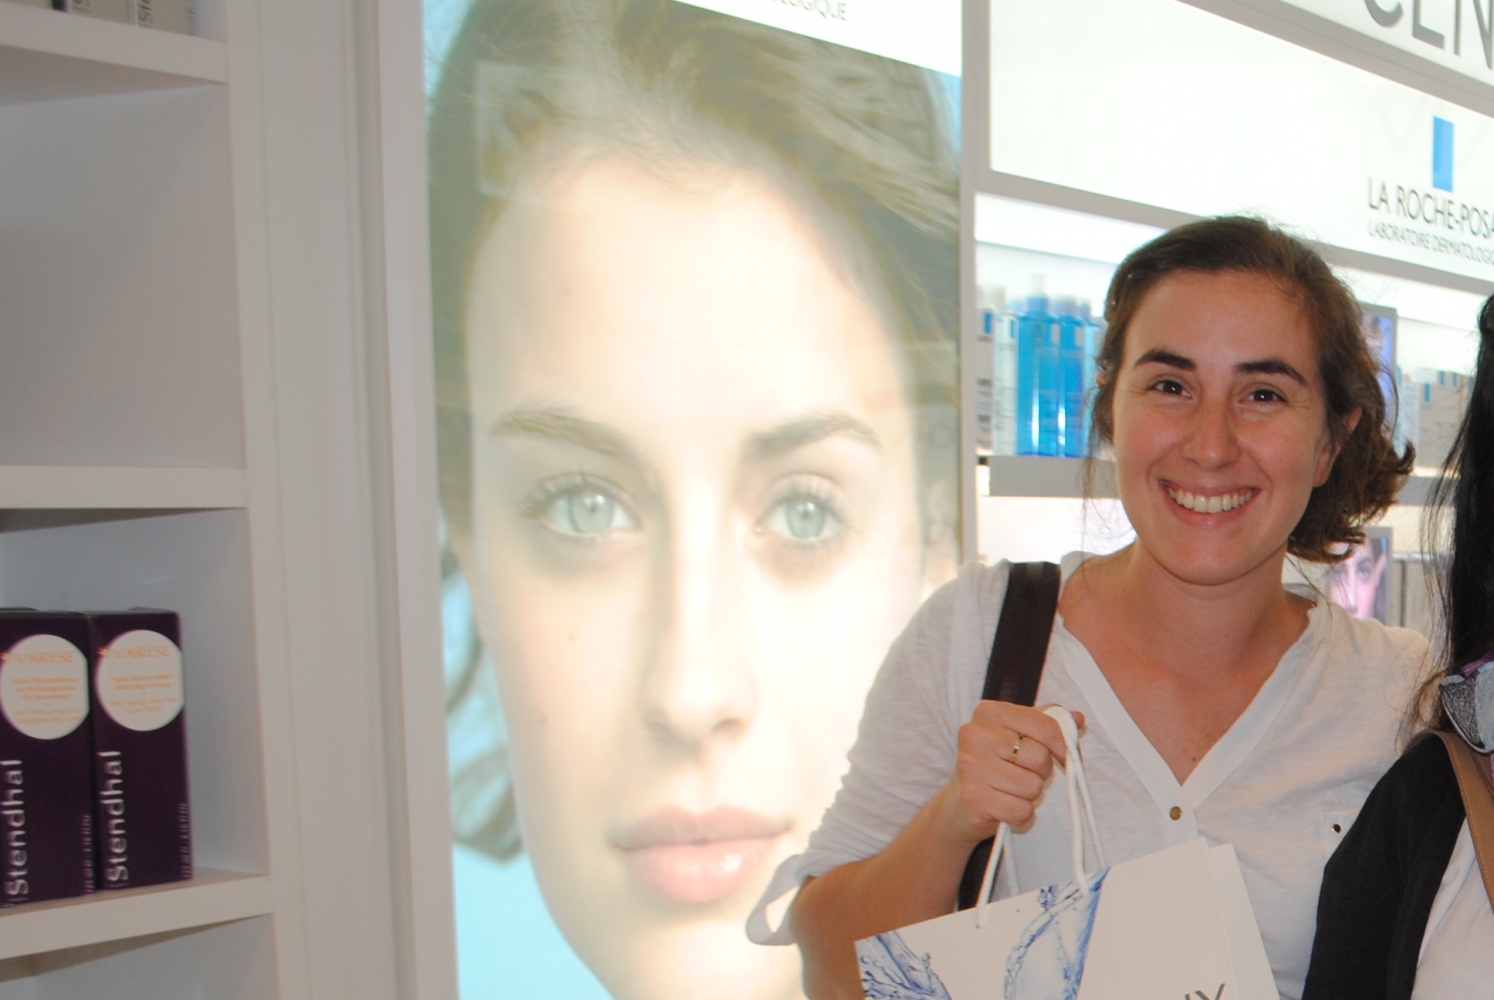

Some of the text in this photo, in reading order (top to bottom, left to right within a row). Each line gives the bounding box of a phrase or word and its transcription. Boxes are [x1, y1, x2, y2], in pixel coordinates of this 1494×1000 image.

[1368, 175, 1391, 214] LA
[1368, 219, 1431, 249] LABORATOIRE
[0, 759, 29, 896] Stendhal
[98, 750, 129, 882] Stendhal
